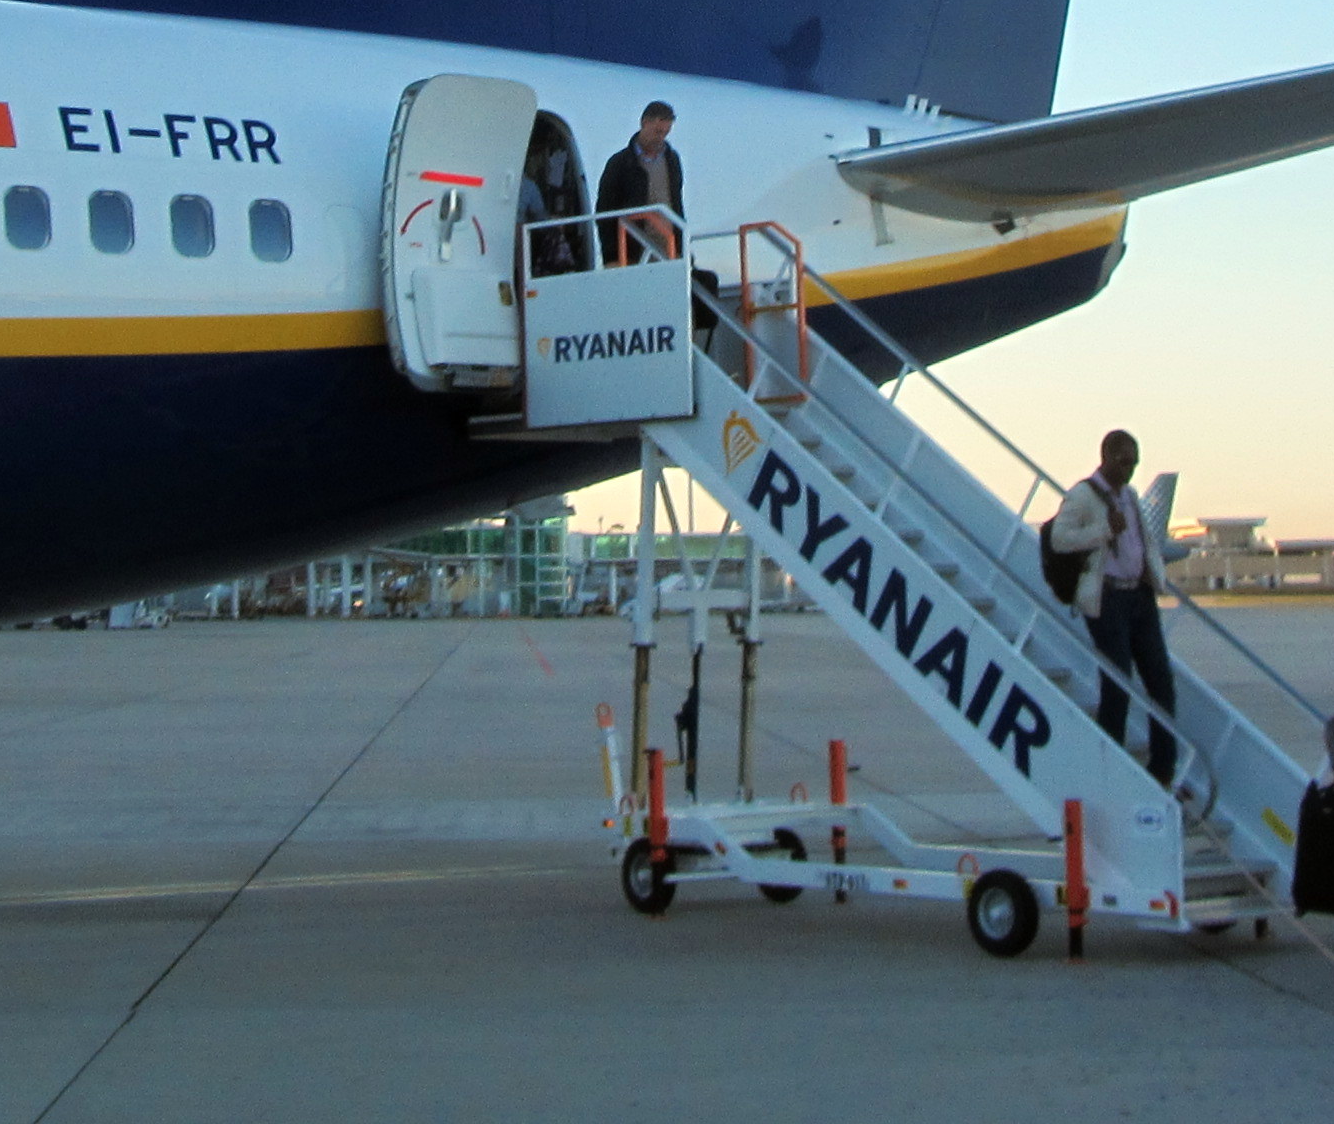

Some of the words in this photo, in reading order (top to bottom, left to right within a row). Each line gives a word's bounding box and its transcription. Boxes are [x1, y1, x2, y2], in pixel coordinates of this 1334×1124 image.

[58, 106, 282, 164] EI-FRR
[553, 325, 675, 364] RYANAIR
[747, 449, 1052, 779] RYANAIR
